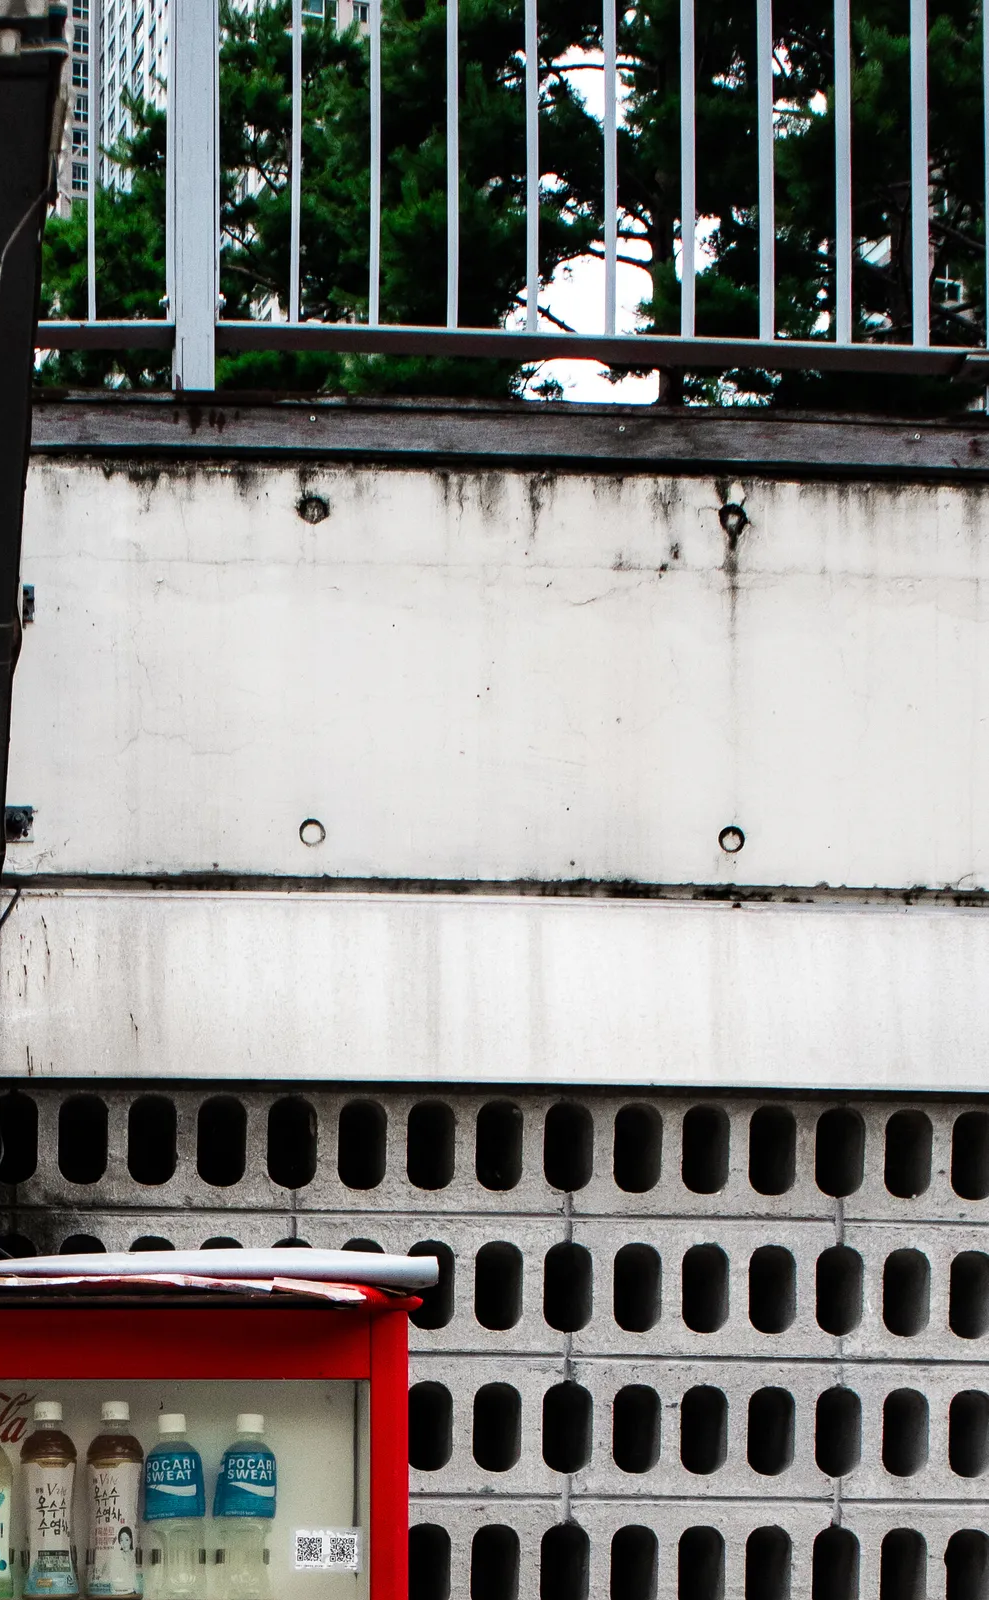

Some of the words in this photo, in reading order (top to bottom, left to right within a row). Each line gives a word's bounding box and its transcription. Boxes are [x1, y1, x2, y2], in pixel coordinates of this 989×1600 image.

[146, 1459, 195, 1471] POCARI
[228, 1458, 276, 1471] POCARI
[146, 1470, 192, 1482] SWEAT
[227, 1469, 273, 1481] SWEAT
[94, 1485, 120, 1506] 옥수수
[36, 1496, 67, 1518] 옥수수
[96, 1507, 122, 1524] 수염차
